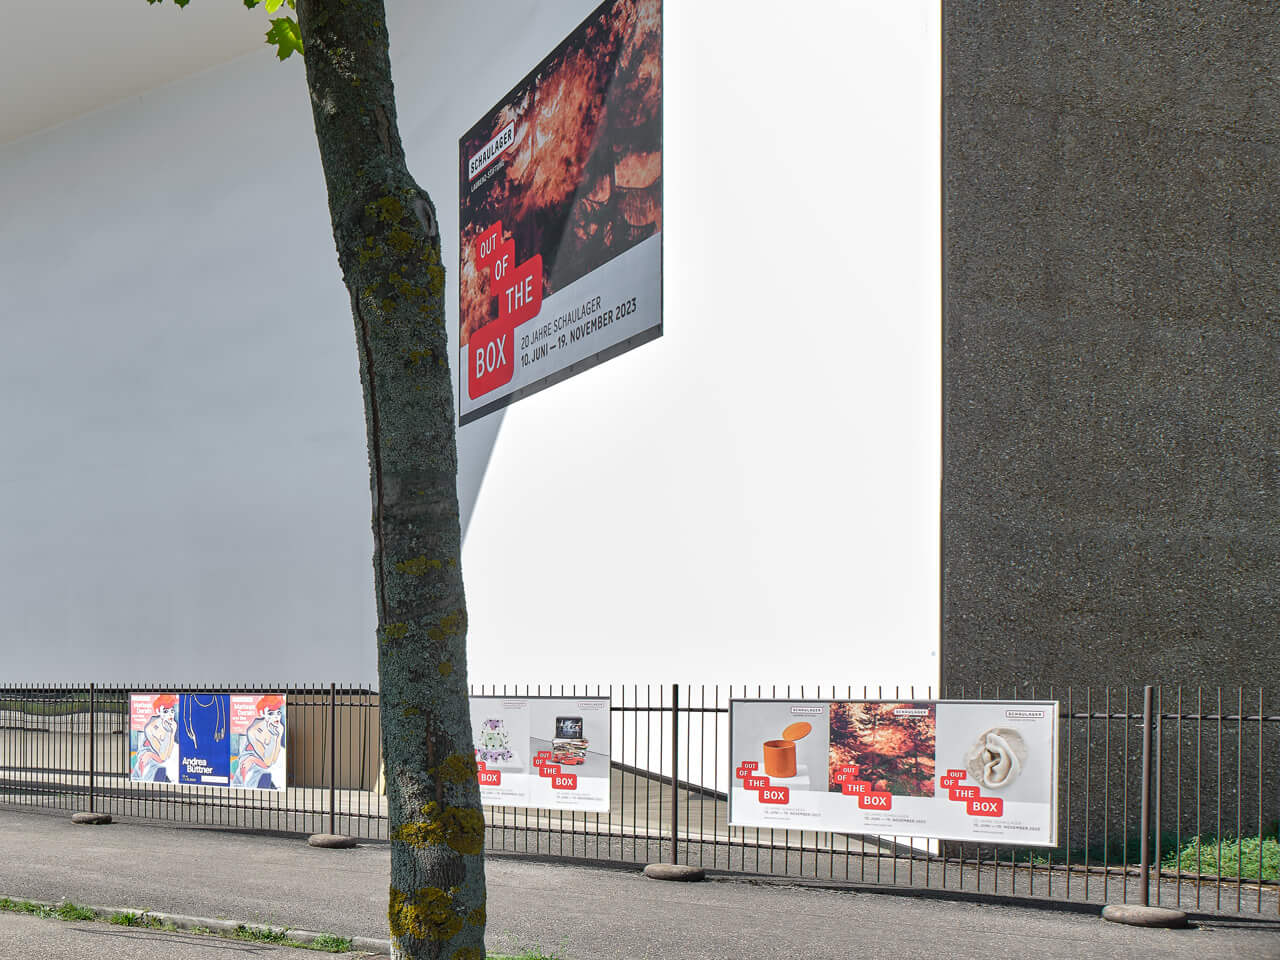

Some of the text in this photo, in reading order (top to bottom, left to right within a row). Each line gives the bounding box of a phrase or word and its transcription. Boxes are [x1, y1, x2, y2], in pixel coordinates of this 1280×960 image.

[471, 129, 512, 173] SCHAULAGER
[480, 233, 497, 258] OUT
[495, 254, 509, 280] OF
[506, 275, 533, 314] THE
[521, 296, 601, 350] 20 JAHRE SCHAULAGER
[521, 352, 531, 368] 10.
[531, 343, 548, 362] JUNI
[557, 334, 568, 349] 19.
[570, 310, 614, 342] NOVEMBER
[615, 297, 637, 320] 2023
[476, 334, 507, 379] BOX
[182, 757, 207, 766] Andrea
[543, 767, 557, 775] THE
[481, 773, 497, 782] BOX
[556, 778, 573, 786] BOX
[848, 784, 866, 792] THE
[763, 790, 785, 800] BOX
[955, 789, 975, 798] THE
[864, 796, 887, 806] BOX
[972, 801, 998, 812] BOX
